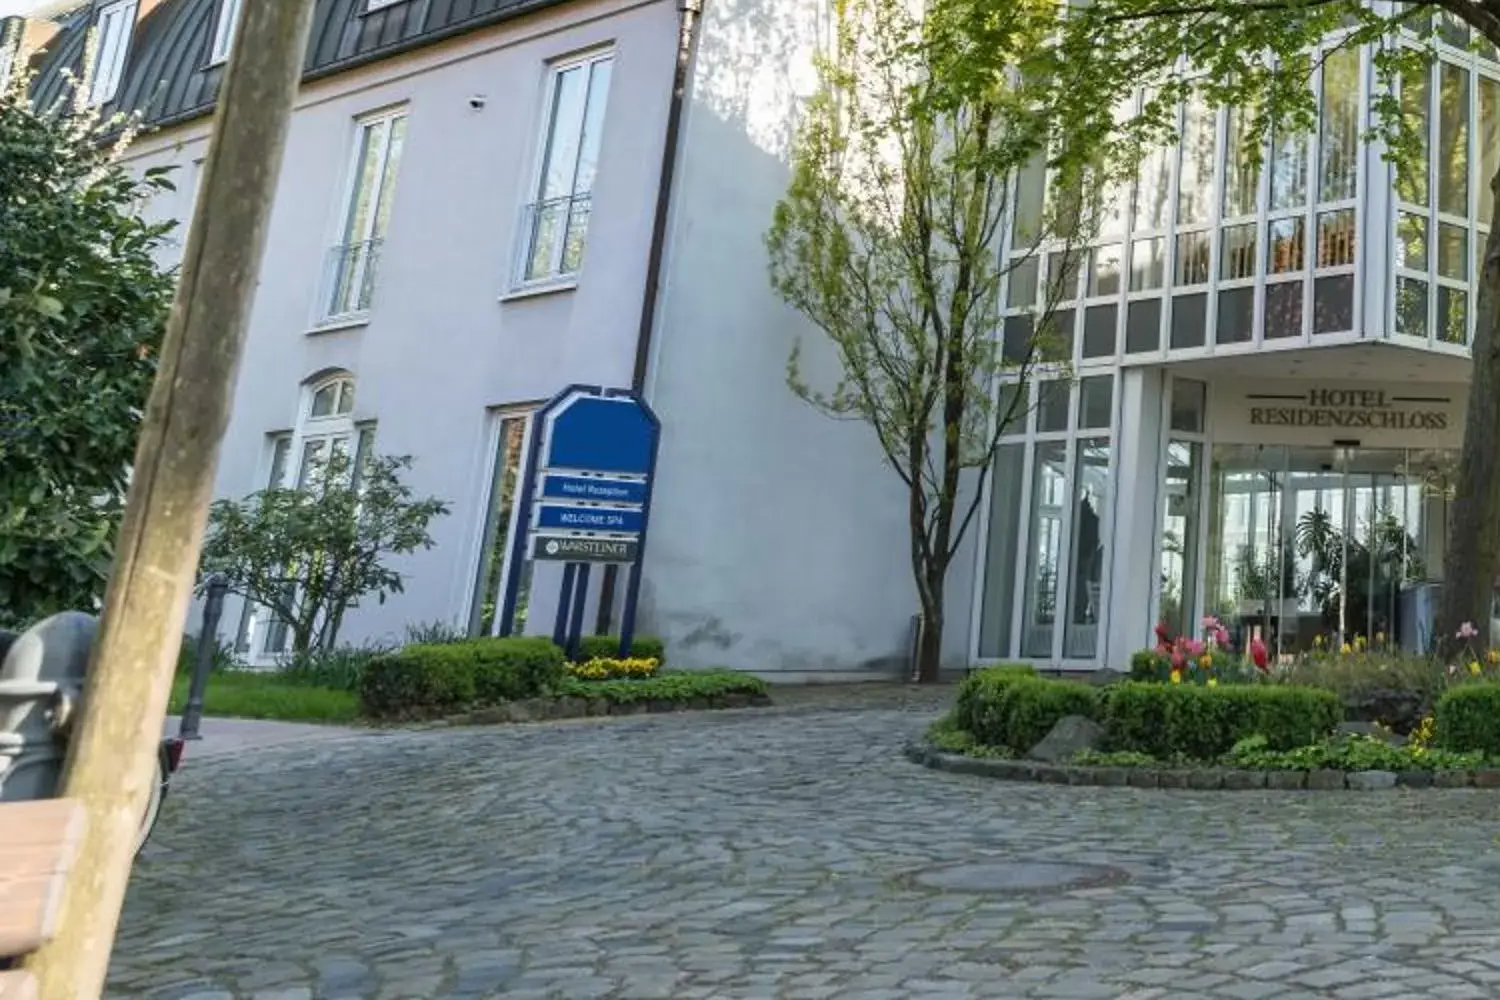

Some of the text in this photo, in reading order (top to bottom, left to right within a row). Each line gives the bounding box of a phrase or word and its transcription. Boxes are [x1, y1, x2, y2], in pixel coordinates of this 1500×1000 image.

[1309, 389, 1392, 407] HOTEL
[1250, 407, 1448, 430] RESIDENZSCHLOSS
[563, 482, 586, 493] Hotel
[560, 513, 623, 525] WELCOME SPA
[559, 539, 628, 554] WARSTEINER
